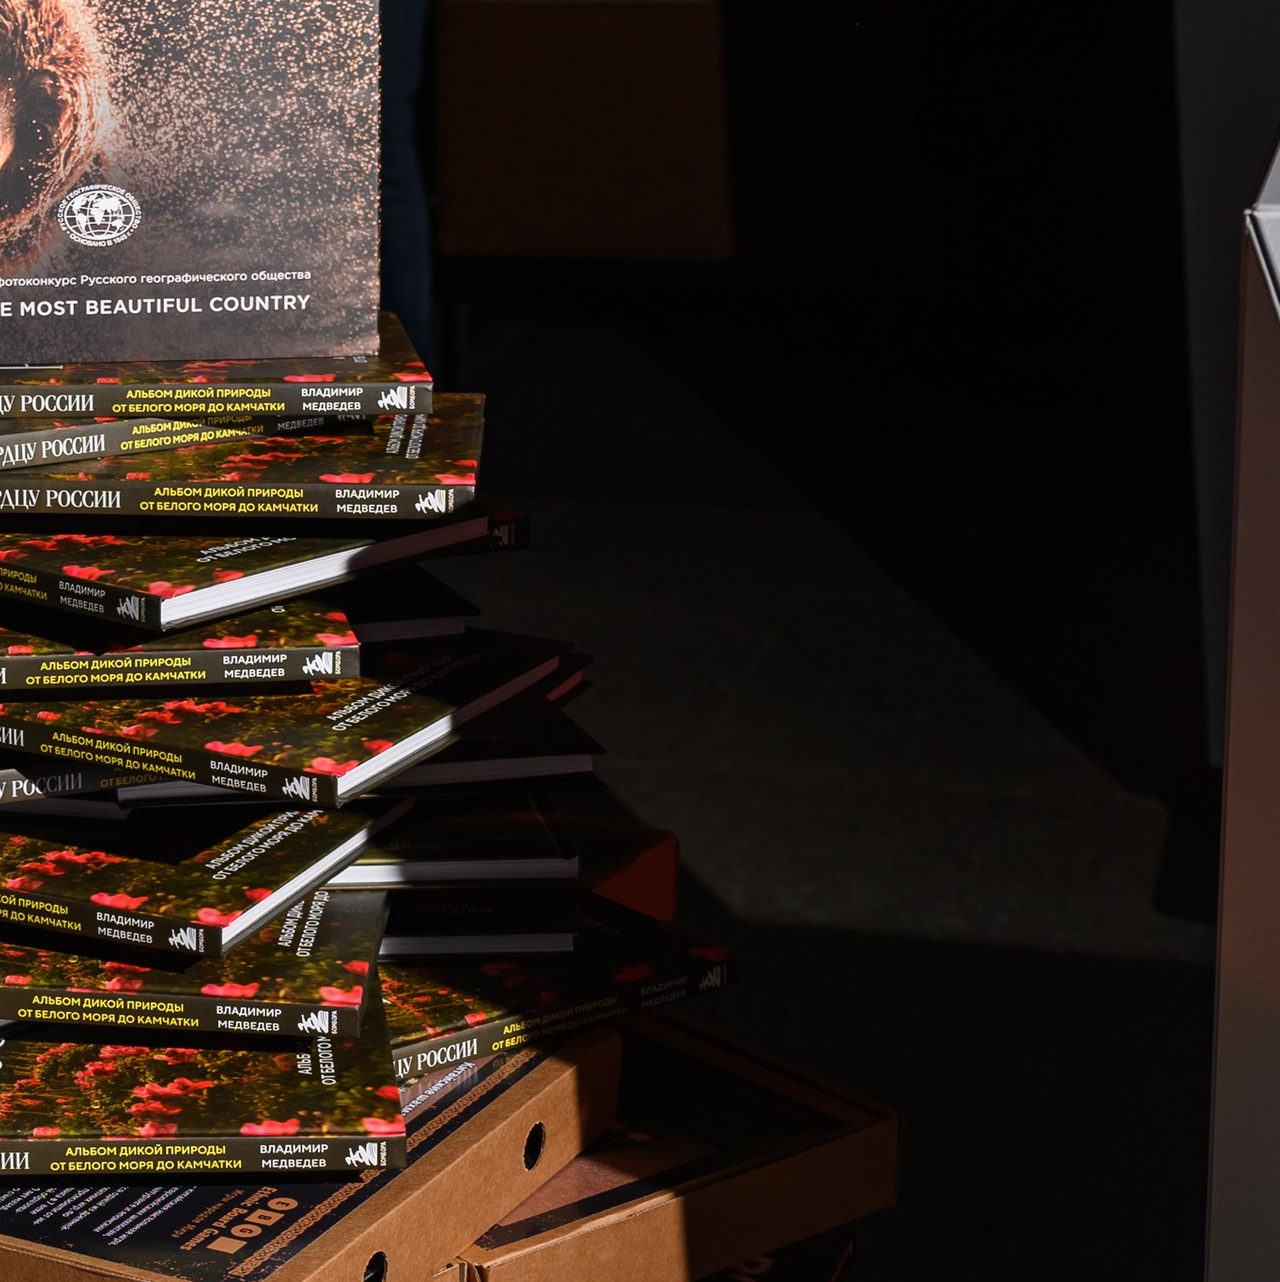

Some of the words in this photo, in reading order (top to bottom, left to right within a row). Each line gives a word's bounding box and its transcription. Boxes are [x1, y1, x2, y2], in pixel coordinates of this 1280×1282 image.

[80, 273, 137, 288] Русского
[140, 270, 248, 286] географического
[251, 268, 312, 282] общества
[19, 300, 78, 317] MOST
[85, 297, 204, 316] BEAUTIFUL
[208, 294, 312, 312] COUNTRY
[126, 389, 176, 400] АЛЬБОМ
[177, 386, 213, 401] ДИКОЙ
[216, 388, 271, 399] ПРИРОДЫ
[301, 386, 363, 399] ВЛАДИМИР
[20, 394, 95, 413] РОССИИ
[112, 403, 128, 413] ОТ
[129, 403, 172, 413] БЕЛОГО
[174, 402, 207, 412] МОРЯ
[208, 402, 224, 414] ДО
[226, 402, 285, 412] КАМЧАТКИ
[302, 400, 361, 412] МЕДВЕДЕВ
[154, 487, 202, 498] АЛЬБОМ
[204, 485, 244, 500] ДИКОЙ
[247, 487, 304, 499] ПРИРОДЫ
[335, 488, 400, 500] ВЛАДИМИР
[46, 490, 121, 509] РОССИИ
[139, 501, 155, 512] ОТ
[156, 501, 202, 512] БЕЛОГО
[204, 502, 236, 513] МОРЯ
[238, 502, 255, 514] ДО
[257, 502, 319, 514] КАМЧАТКИ
[336, 502, 398, 514] МЕДВЕДЕВ
[40, 660, 89, 671] АЛЬБОМ
[91, 657, 132, 672] ДИКОЙ
[135, 657, 191, 668] ПРИРОДЫ
[222, 653, 288, 665] ВЛАДИМИР
[25, 675, 42, 686] ОТ
[43, 674, 89, 685] БЕЛОГО
[90, 673, 124, 684] МОРЯ
[125, 672, 143, 684] ДО
[145, 669, 206, 681] КАМЧАТКИ
[224, 668, 286, 679] МЕДВЕДЕВ
[32, 996, 81, 1008] АЛЬБОМ
[83, 996, 124, 1011] ДИКОЙ
[127, 1001, 184, 1013] ПРИРОДЫ
[18, 1008, 34, 1018] ОТ
[35, 1010, 80, 1021] БЕЛОГО
[82, 1012, 115, 1023] МОРЯ
[118, 1014, 135, 1026] ДО
[137, 1015, 199, 1028] КАМЧАТКИ
[216, 1006, 282, 1017] ВЛАДИМИР
[217, 1020, 280, 1032] МЕДВЕДЕВ
[417, 1038, 478, 1071] РОССИИ
[66, 1146, 117, 1157] АЛЬБОМ
[119, 1144, 162, 1157] ДИКОЙ
[165, 1145, 226, 1155] ПРИРОДЫ
[260, 1143, 329, 1155] ВЛАДИМИР
[50, 1161, 68, 1171] ОТ
[69, 1161, 117, 1171] БЕЛОГО
[120, 1160, 154, 1171] МОРЯ
[156, 1160, 174, 1172] ДО
[177, 1159, 242, 1170] КАМЧАТКИ
[261, 1157, 327, 1169] МЕДВЕДЕВ
[212, 1207, 249, 1229] Board
[179, 1228, 219, 1251] Games
